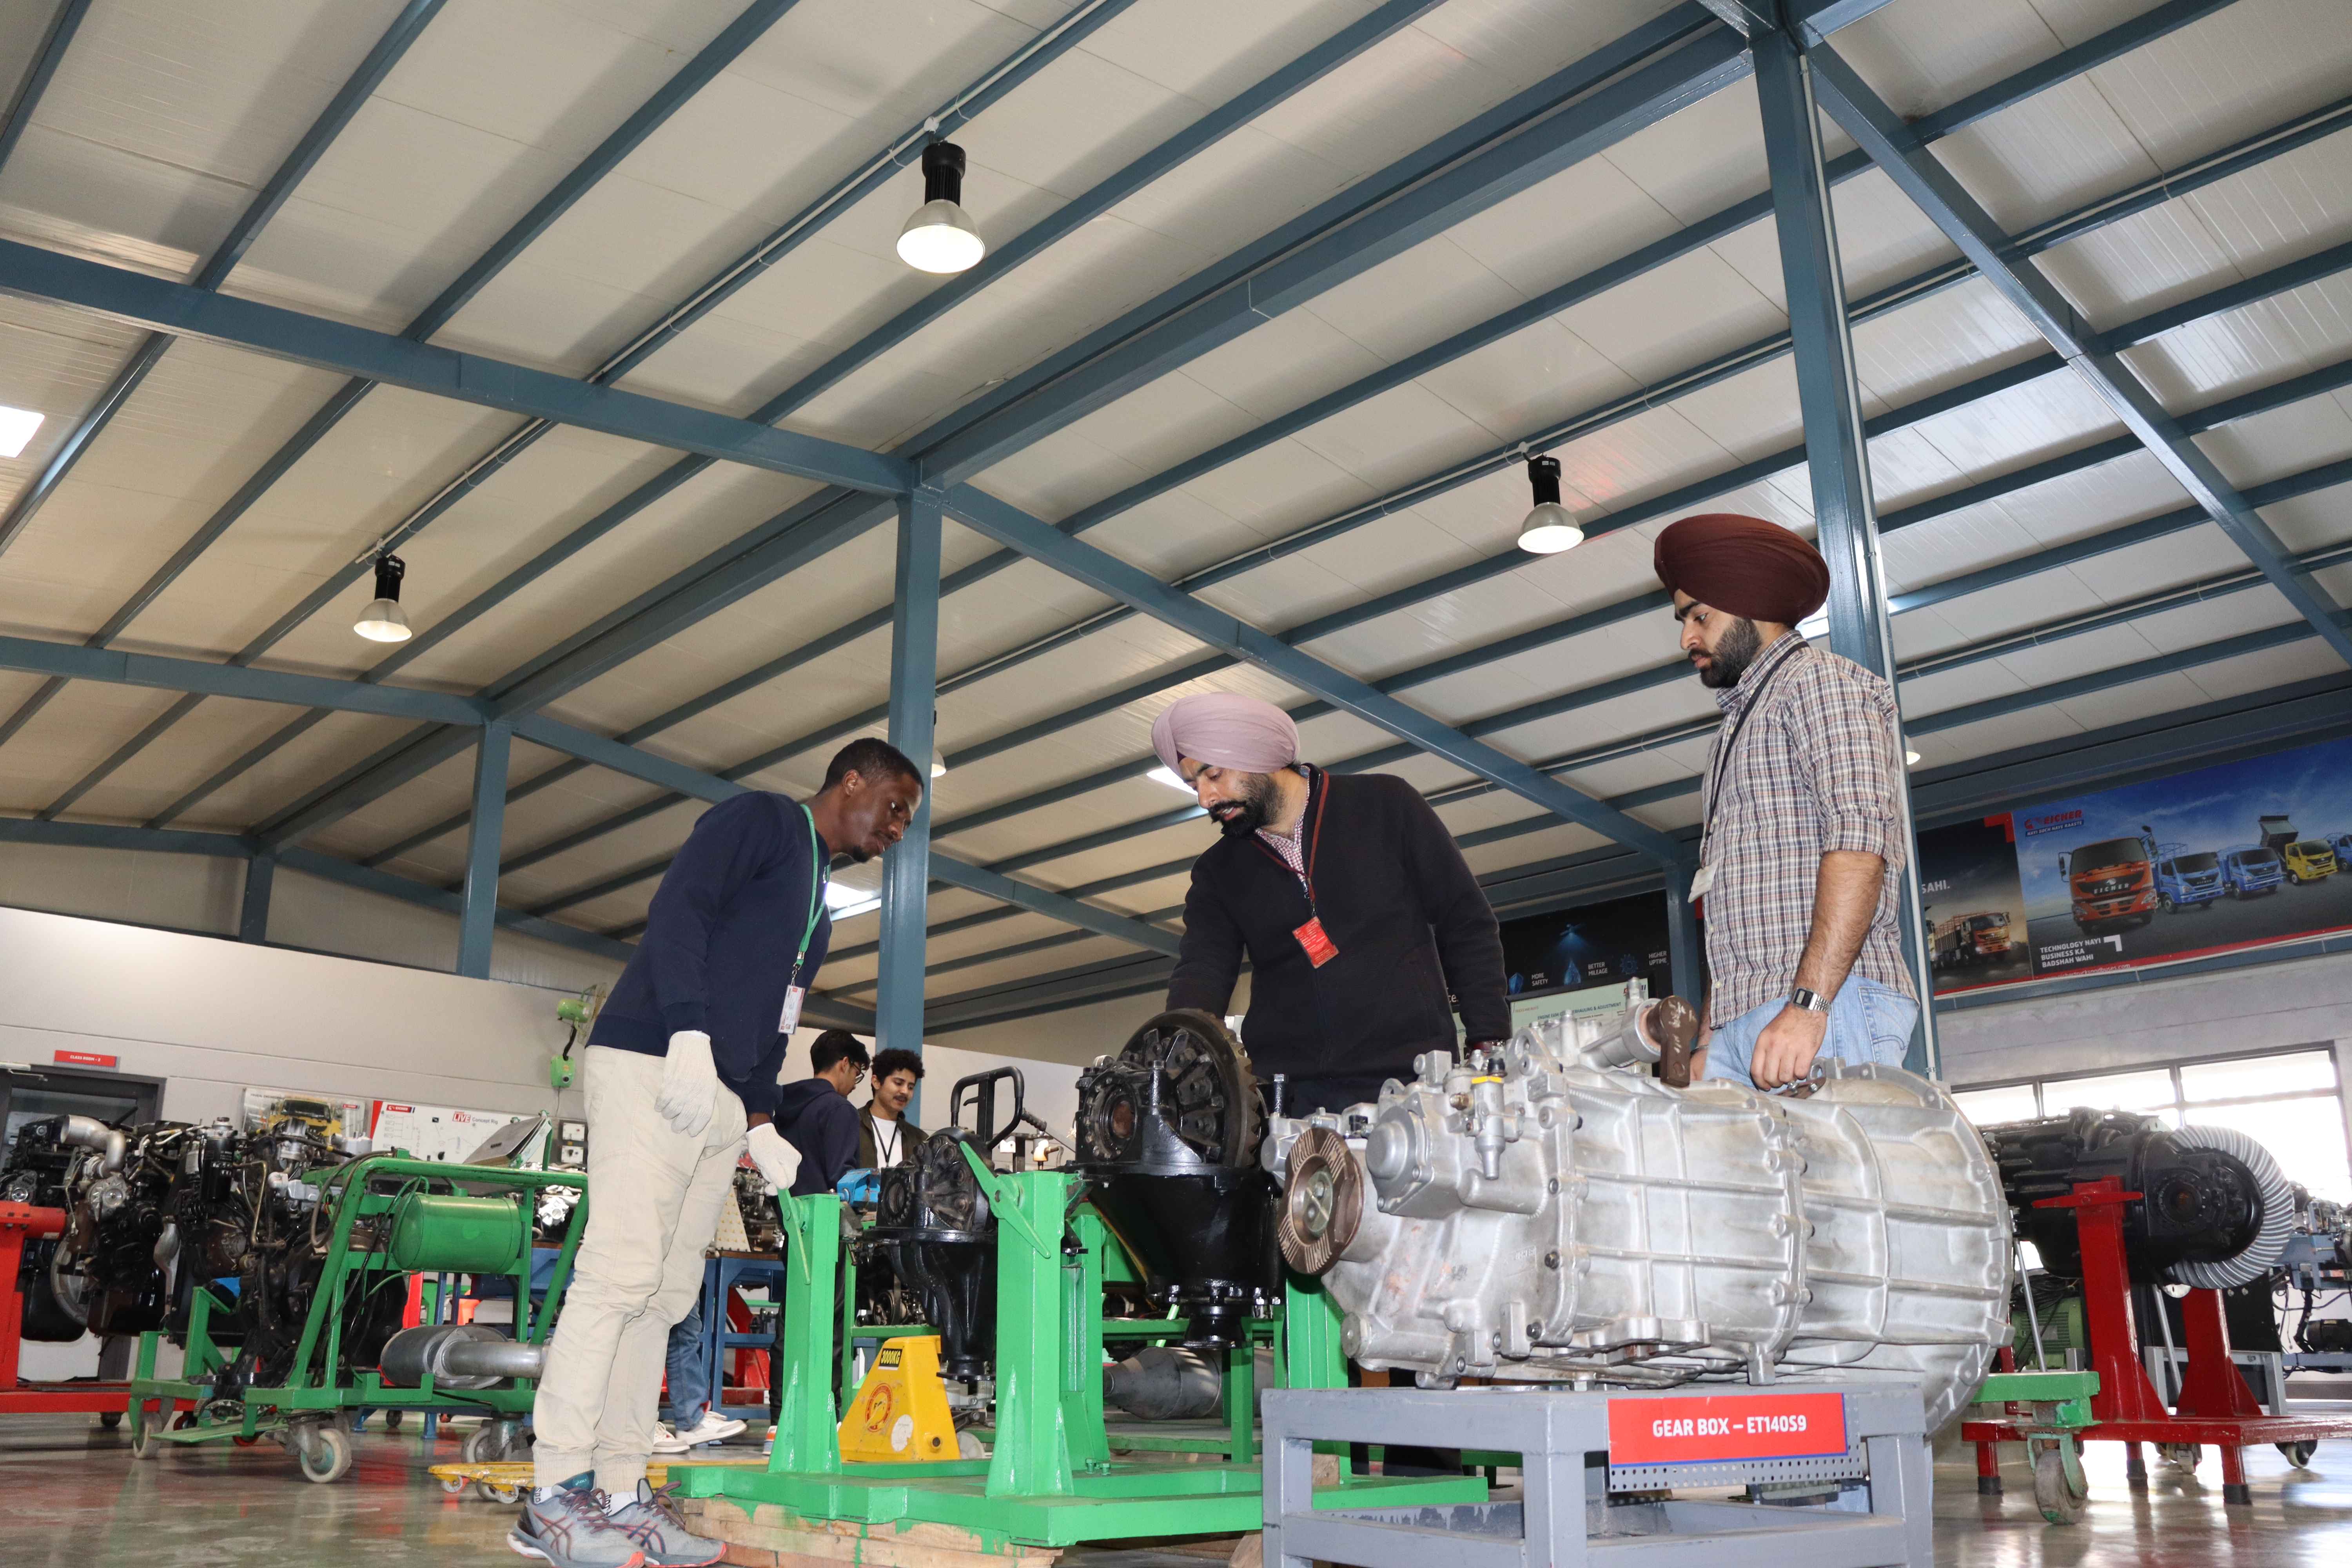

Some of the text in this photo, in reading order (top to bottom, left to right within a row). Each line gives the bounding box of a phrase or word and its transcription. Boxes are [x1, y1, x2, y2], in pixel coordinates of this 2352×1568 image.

[2044, 809, 2082, 824] EICHER
[1921, 880, 1951, 894] SAHI.
[2094, 883, 2129, 894] EICHER
[2040, 938, 2101, 953] TECHNOLOGY NAYI
[1649, 957, 1667, 965] UPTIME
[2041, 949, 2074, 961] BUSINESS
[2042, 954, 2094, 968] BADSHAH WAHI
[453, 1114, 471, 1123] LIVE
[881, 1350, 900, 1365] 3000KG
[1653, 1419, 1693, 1437] GEAR
[1697, 1417, 1730, 1435] BOX
[1747, 1415, 1807, 1434] ET140S9
